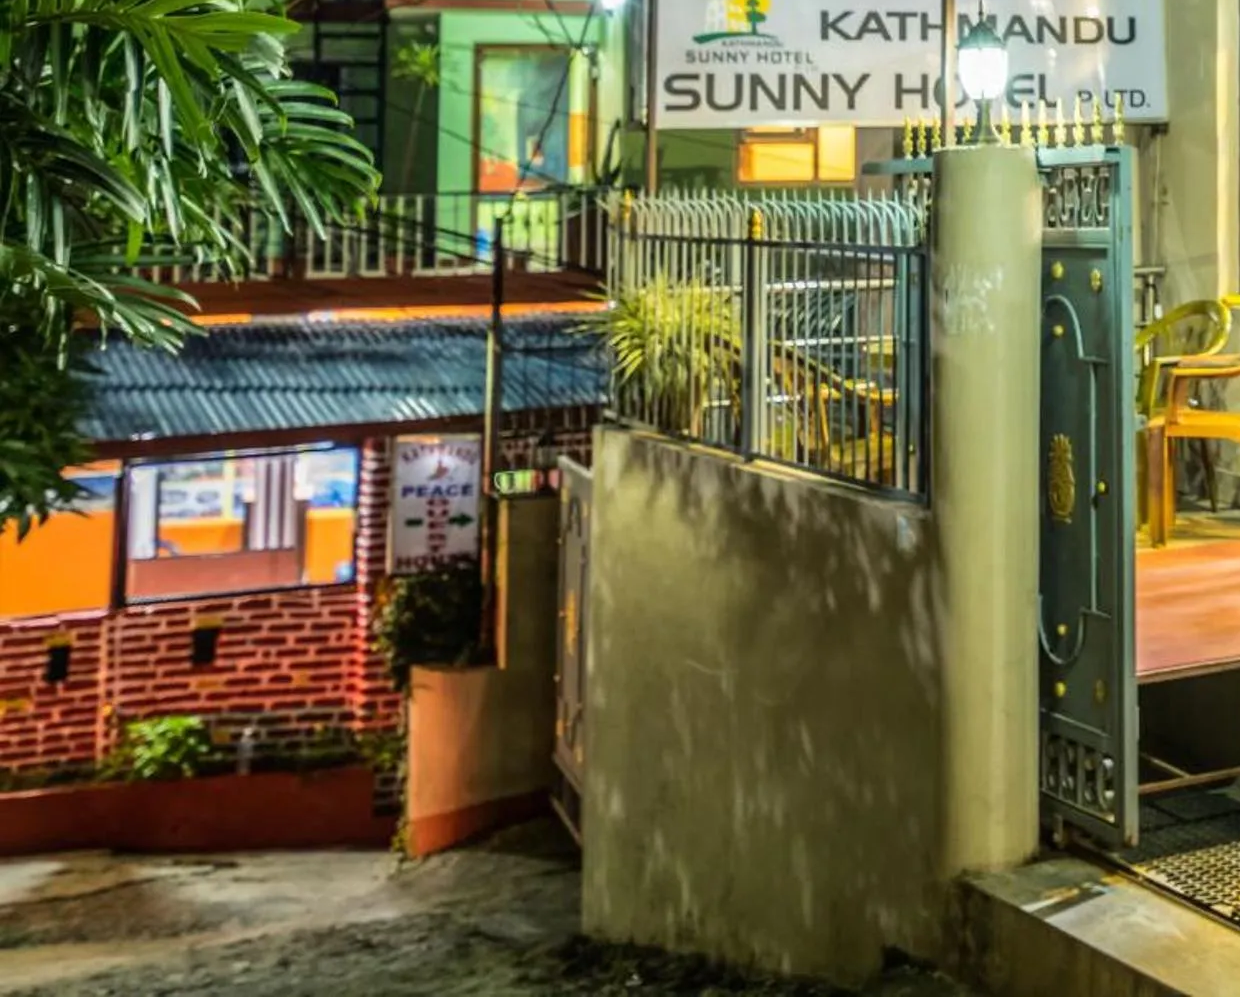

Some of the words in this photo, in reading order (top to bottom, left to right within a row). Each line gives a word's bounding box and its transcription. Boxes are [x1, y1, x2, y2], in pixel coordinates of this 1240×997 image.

[685, 49, 749, 64] SUNNY
[757, 50, 814, 64] HOTEL
[663, 73, 871, 111] SUNNY
[895, 73, 1057, 109] HOEL
[401, 483, 473, 499] PEACE
